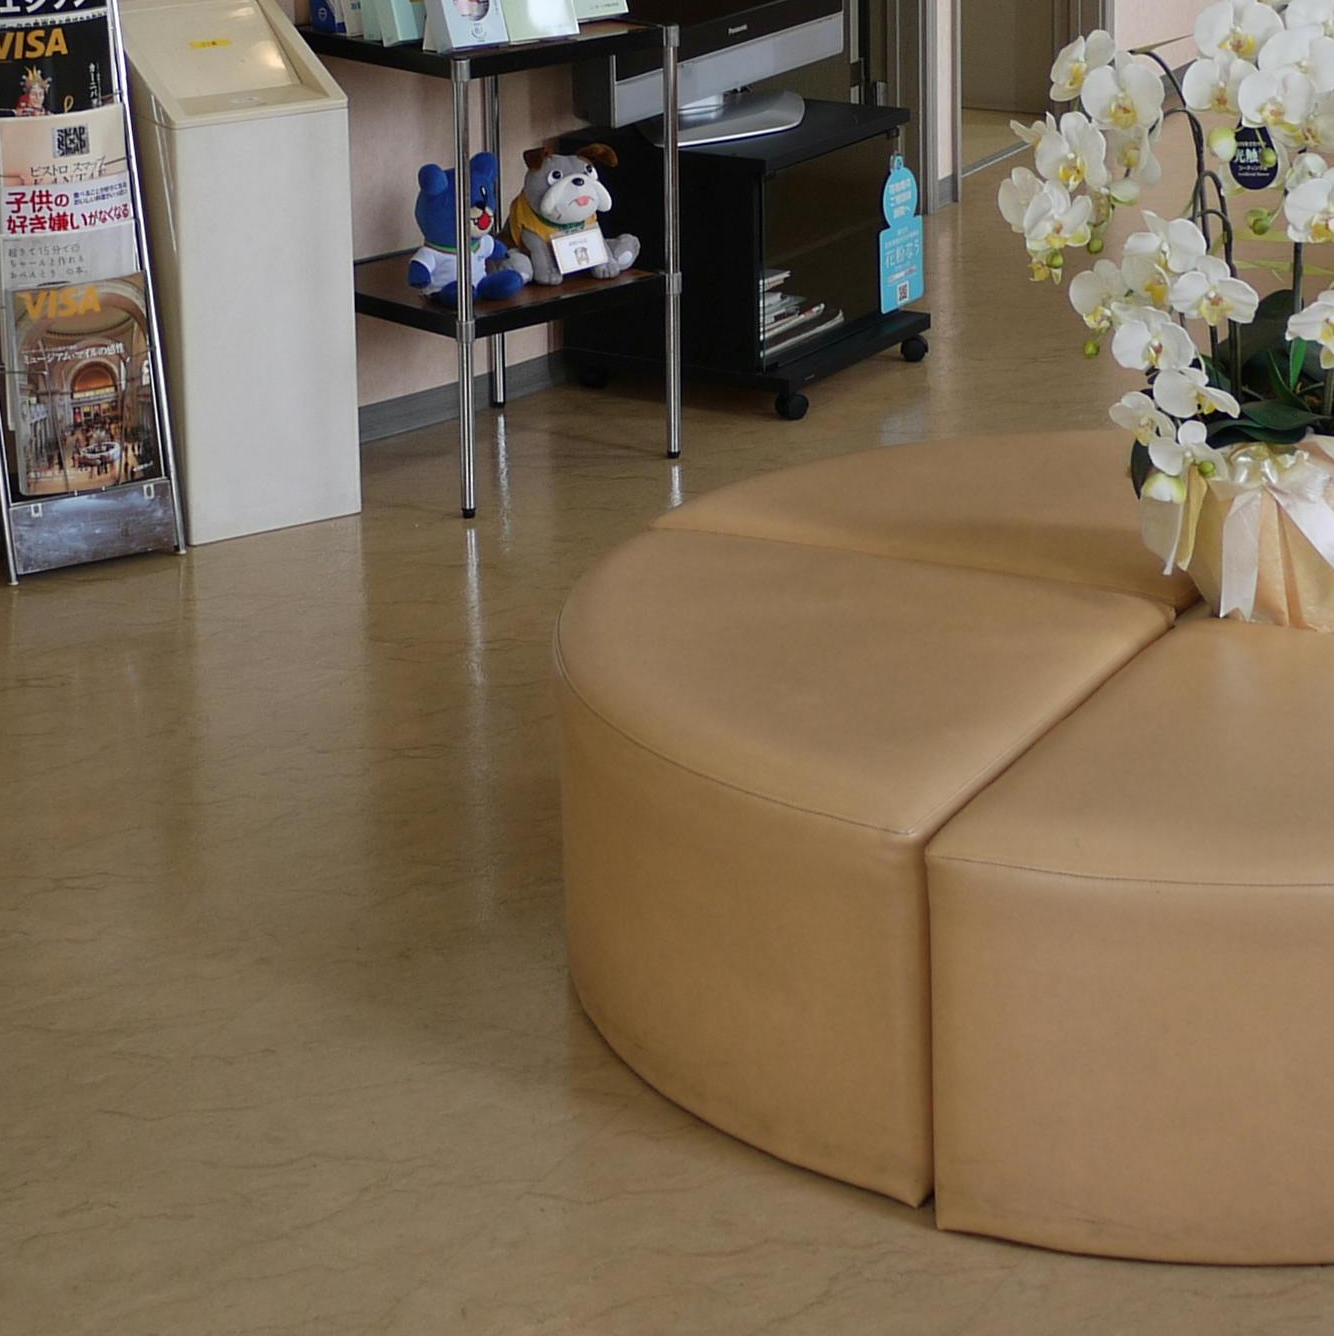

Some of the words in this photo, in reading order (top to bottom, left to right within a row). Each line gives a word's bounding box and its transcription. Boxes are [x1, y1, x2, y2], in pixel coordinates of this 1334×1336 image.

[30, 164, 67, 178] ビストロ
[6, 189, 70, 214] 子供の
[6, 202, 130, 234] 好き嫌いがなくなる
[20, 285, 102, 320] VISA
